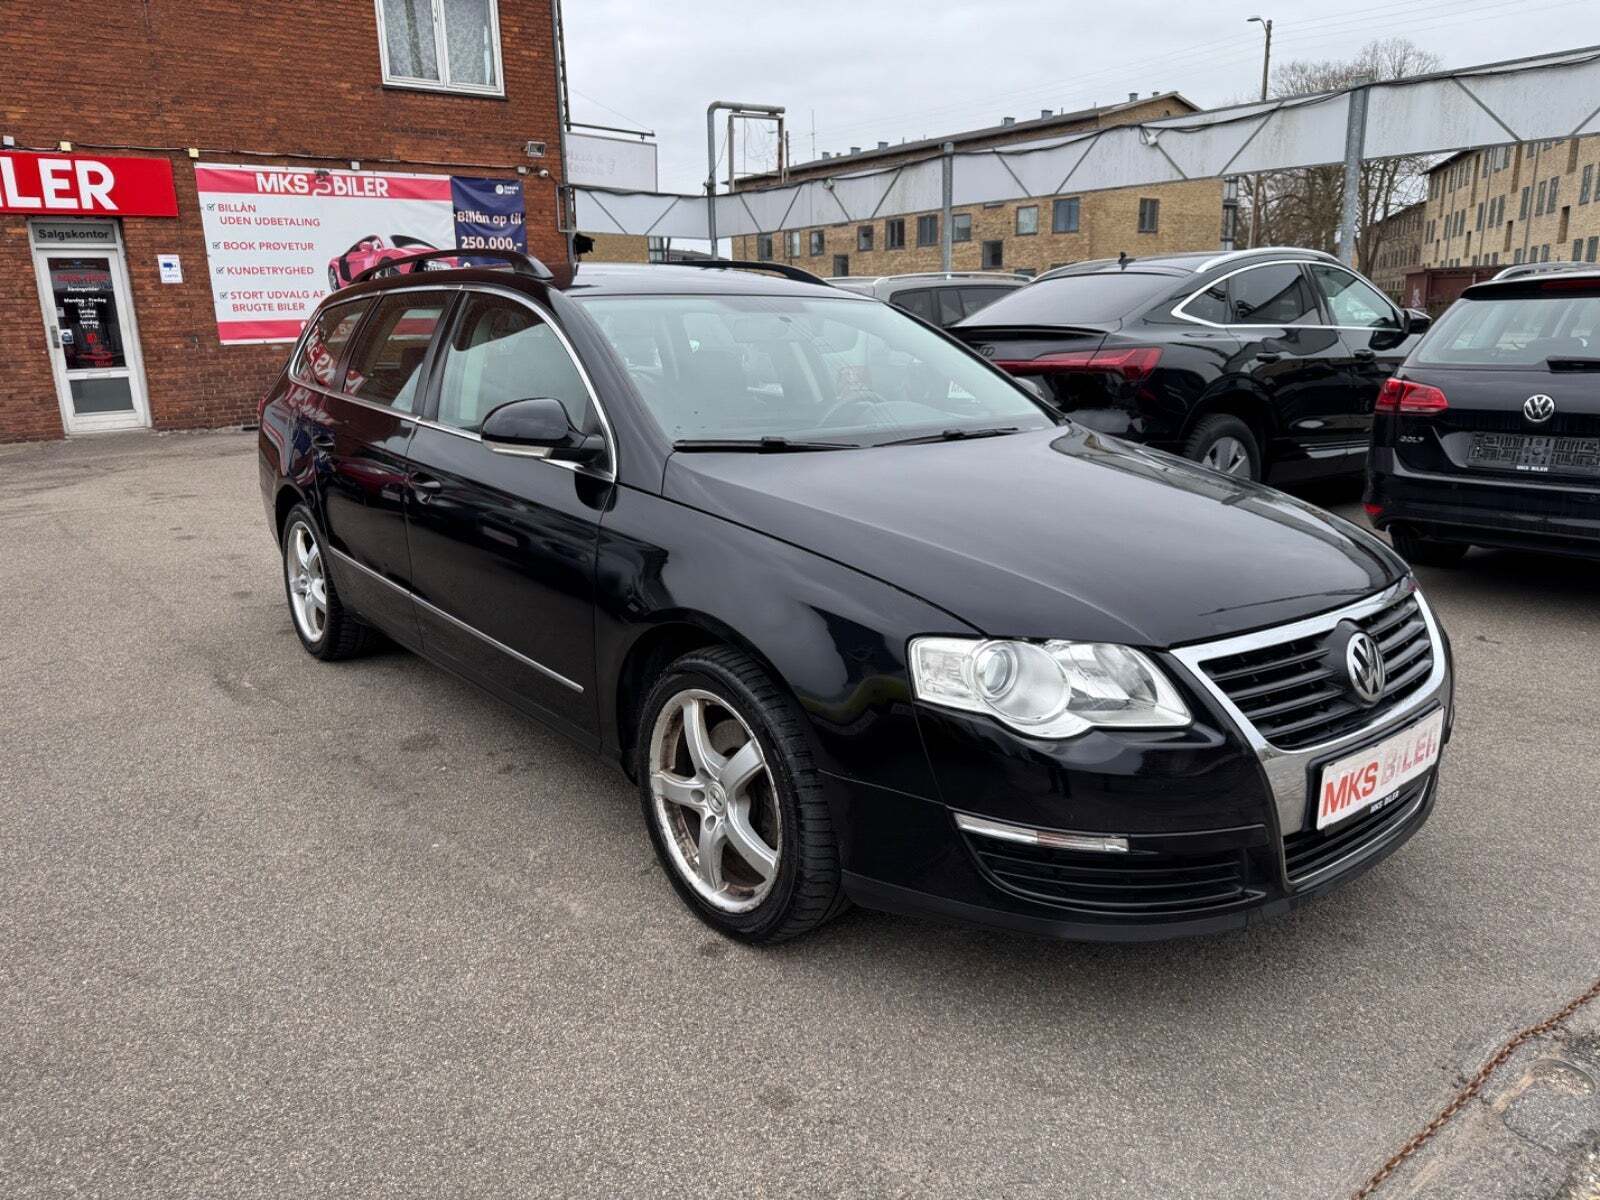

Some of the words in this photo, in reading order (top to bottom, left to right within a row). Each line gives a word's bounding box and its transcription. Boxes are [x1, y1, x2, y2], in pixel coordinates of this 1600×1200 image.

[0, 157, 119, 210] LER
[255, 172, 310, 194] MKS
[332, 175, 389, 197] BILER
[218, 202, 257, 212] BILLÅN
[220, 216, 252, 225] UDEN
[254, 217, 321, 227] UDBETALING
[457, 210, 490, 224] Billån
[492, 214, 507, 227] op
[510, 213, 521, 225] til
[38, 228, 110, 241] Salgskontor
[223, 241, 256, 250] BOOK
[259, 242, 315, 251] PRØVETUR
[461, 236, 523, 251] 250.000,-
[227, 266, 315, 276] KUNDETRYGHED
[230, 291, 263, 300] STORT
[267, 290, 310, 300] UDVALG
[313, 290, 326, 299] AF
[232, 303, 274, 312] BRUGTE
[278, 303, 305, 311] BILER
[1322, 761, 1379, 818] MKS
